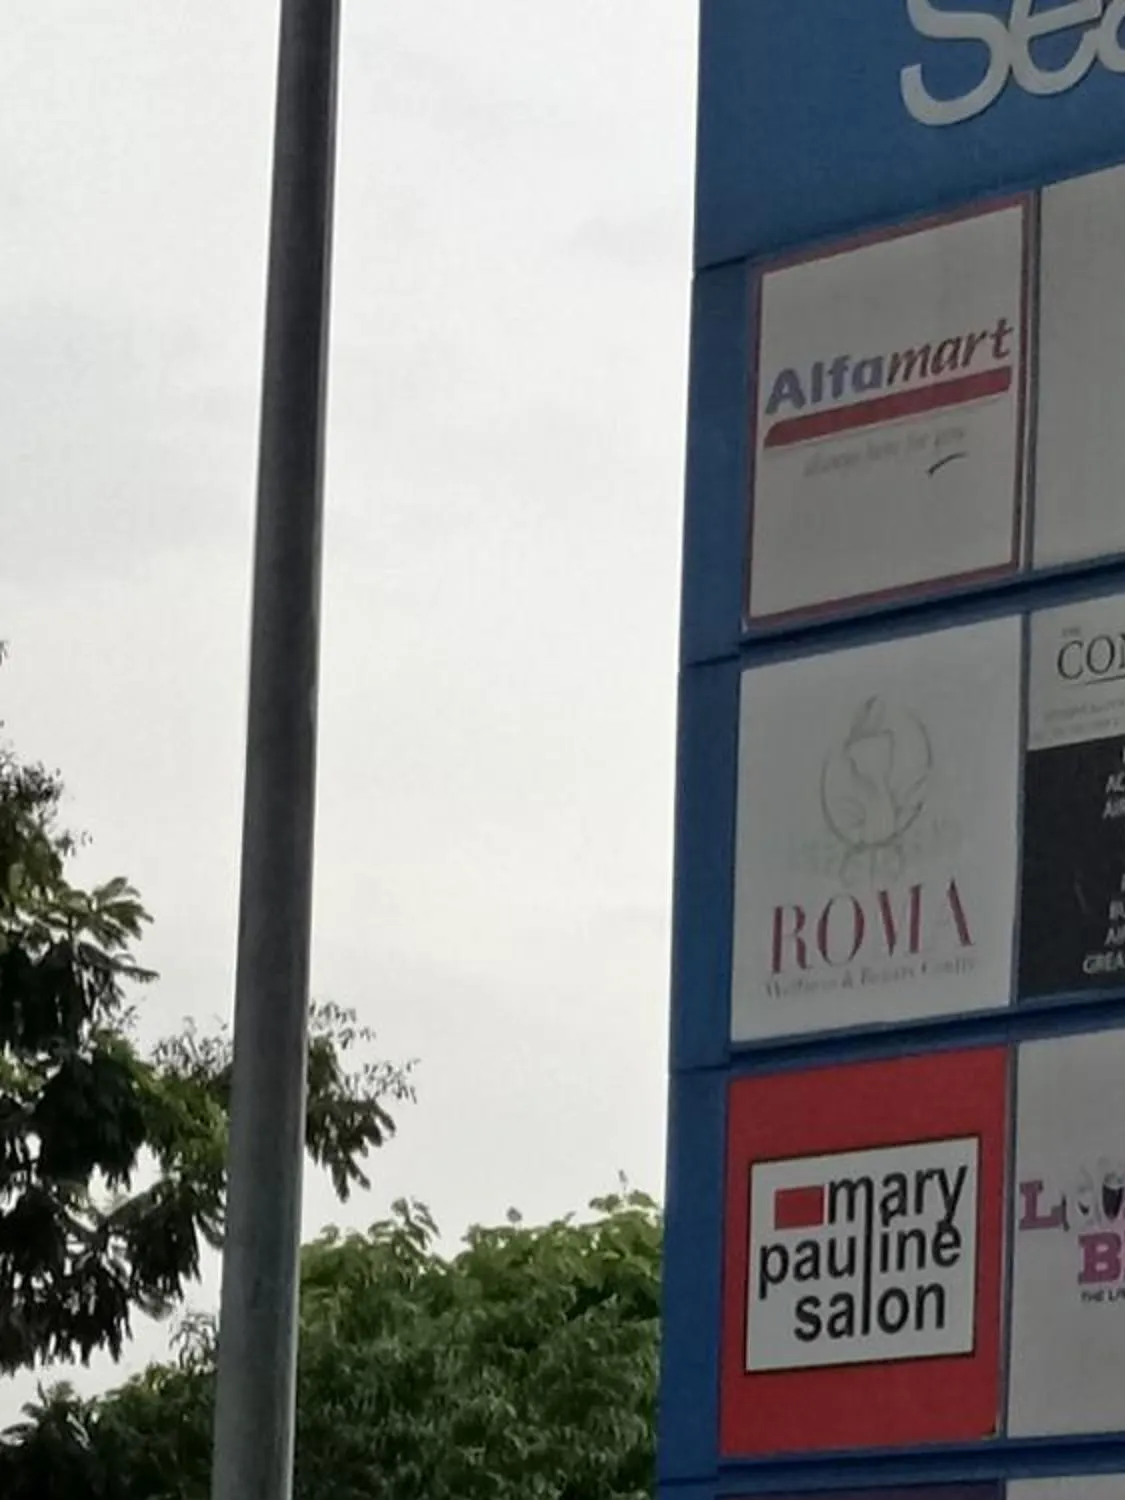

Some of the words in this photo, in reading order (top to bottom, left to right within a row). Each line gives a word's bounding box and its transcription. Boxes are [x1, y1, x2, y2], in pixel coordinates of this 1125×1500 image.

[765, 316, 1014, 415] Alfamart
[771, 876, 976, 975] ROMA
[828, 1165, 968, 1228] mary
[759, 1216, 962, 1301] pauline
[794, 1278, 946, 1342] salon
